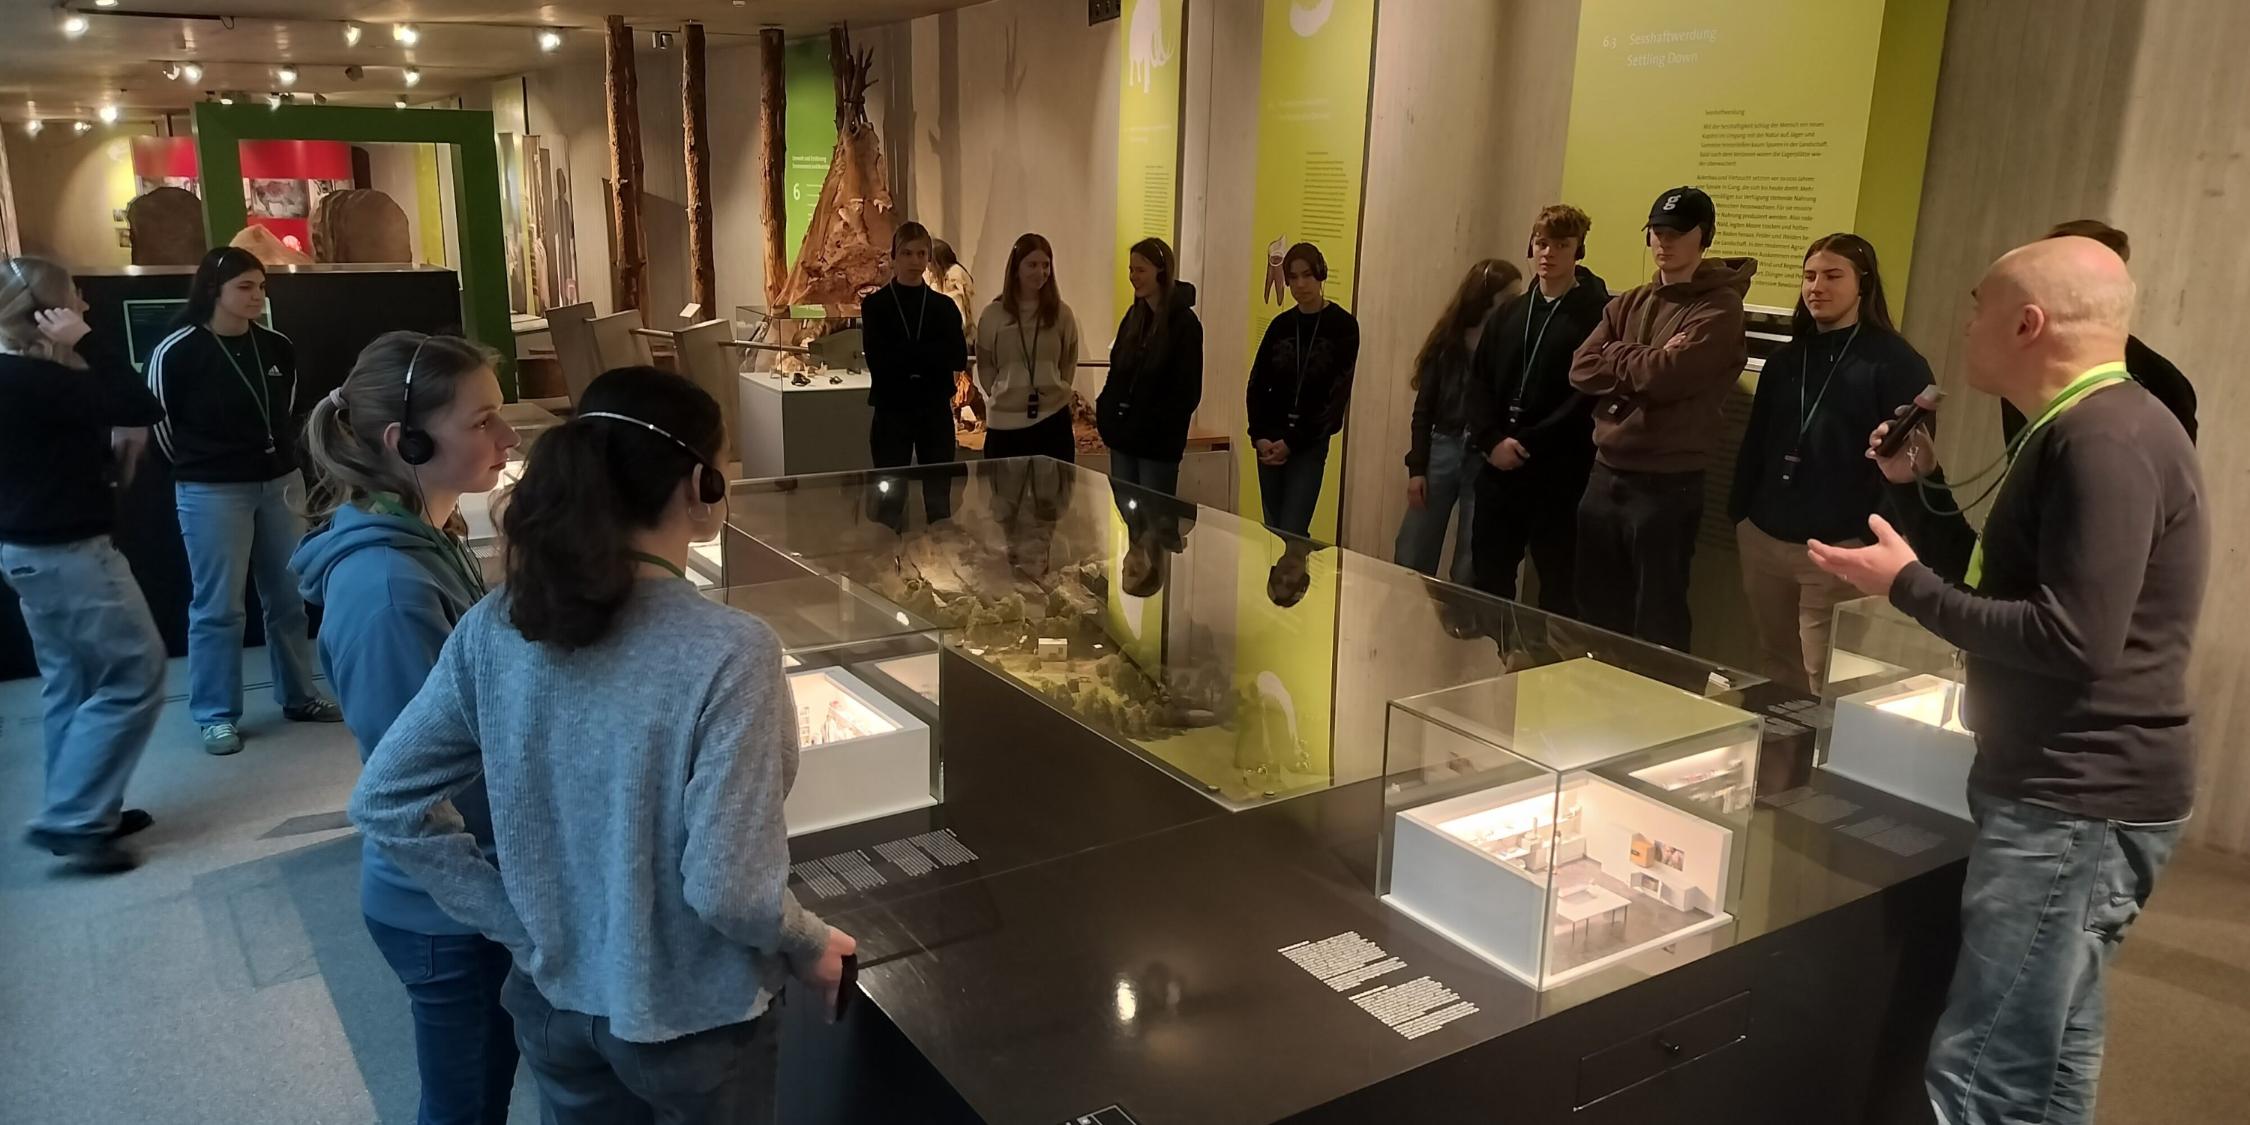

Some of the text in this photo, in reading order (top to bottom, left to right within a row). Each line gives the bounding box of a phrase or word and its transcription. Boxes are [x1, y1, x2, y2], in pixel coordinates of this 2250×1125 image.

[1627, 51, 1699, 69] Settling Down
[793, 182, 801, 200] 6
[1662, 194, 1682, 211] g
